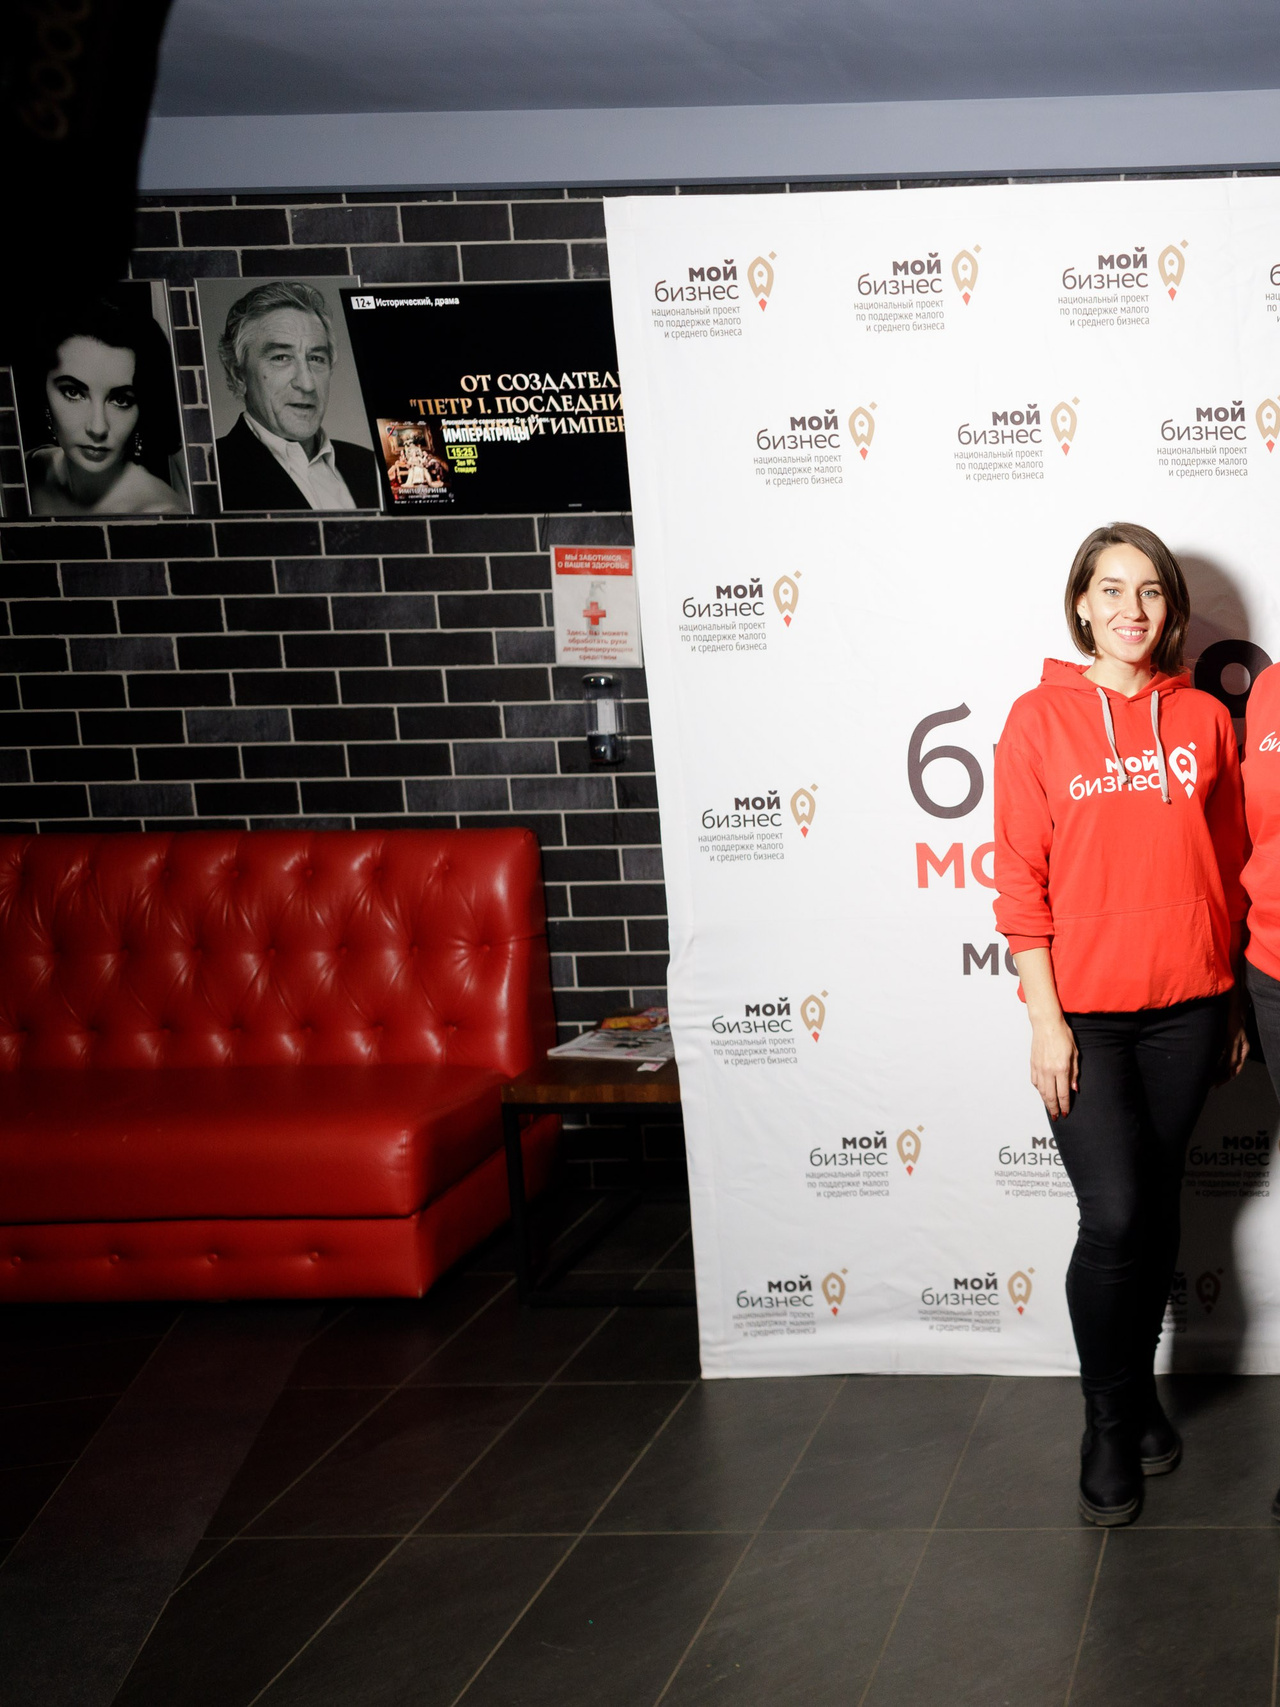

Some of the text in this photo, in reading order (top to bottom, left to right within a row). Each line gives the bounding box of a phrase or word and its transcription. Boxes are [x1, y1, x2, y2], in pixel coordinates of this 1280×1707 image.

[892, 252, 941, 275] мой
[1098, 247, 1147, 269] мой
[688, 259, 737, 282] мой
[1062, 267, 1148, 289] бизнес
[655, 280, 739, 302] бизнес
[858, 273, 943, 295] бизнес
[355, 298, 371, 308] 12+
[376, 296, 460, 308] Исторический, драма
[1058, 295, 1149, 305] национальный проект
[651, 306, 740, 317] национальный проект
[1072, 307, 1117, 316] поддержке
[1120, 306, 1149, 314] малого
[666, 319, 710, 328] поддержке
[1077, 318, 1114, 328] среднего
[1117, 316, 1149, 325] бизнеса
[671, 330, 707, 340] среднего
[710, 327, 742, 336] бизнеса
[460, 371, 621, 394] ОТ СОЗДАТЕЛ
[478, 397, 492, 414] I.
[992, 404, 1040, 426] мой
[1196, 400, 1245, 422] мой
[790, 409, 838, 431] мой
[1161, 419, 1246, 440] бизнес
[443, 426, 530, 443] ИМПЕРАТРИЦЫ
[757, 428, 840, 450] бизнес
[958, 423, 1042, 445] бизнес
[451, 447, 474, 457] 15:25
[954, 450, 1043, 460] национальный проект
[968, 462, 1013, 471] поддержке
[974, 472, 1009, 482] среднего
[1012, 470, 1044, 479] бизнеса
[591, 562, 630, 570] ЗДОРОВЬЕ
[716, 578, 763, 599] мой
[683, 597, 765, 617] бизнес
[734, 790, 780, 811] мой
[702, 809, 782, 828] бизнес
[698, 833, 783, 842] национальный проект
[712, 844, 754, 852] поддержке
[717, 854, 751, 863] среднего
[753, 852, 784, 860] бизнеса
[744, 997, 791, 1017] мой
[713, 1015, 793, 1034] бизнес
[842, 1130, 887, 1149] мой
[1031, 1135, 1058, 1149] мо
[1223, 1131, 1268, 1150] мой
[810, 1147, 888, 1166] бизнес
[1191, 1147, 1269, 1166] бизнес
[768, 1274, 812, 1293] мой
[954, 1271, 998, 1290] мой
[736, 1291, 813, 1309] бизнес
[922, 1288, 999, 1306] бизнес
